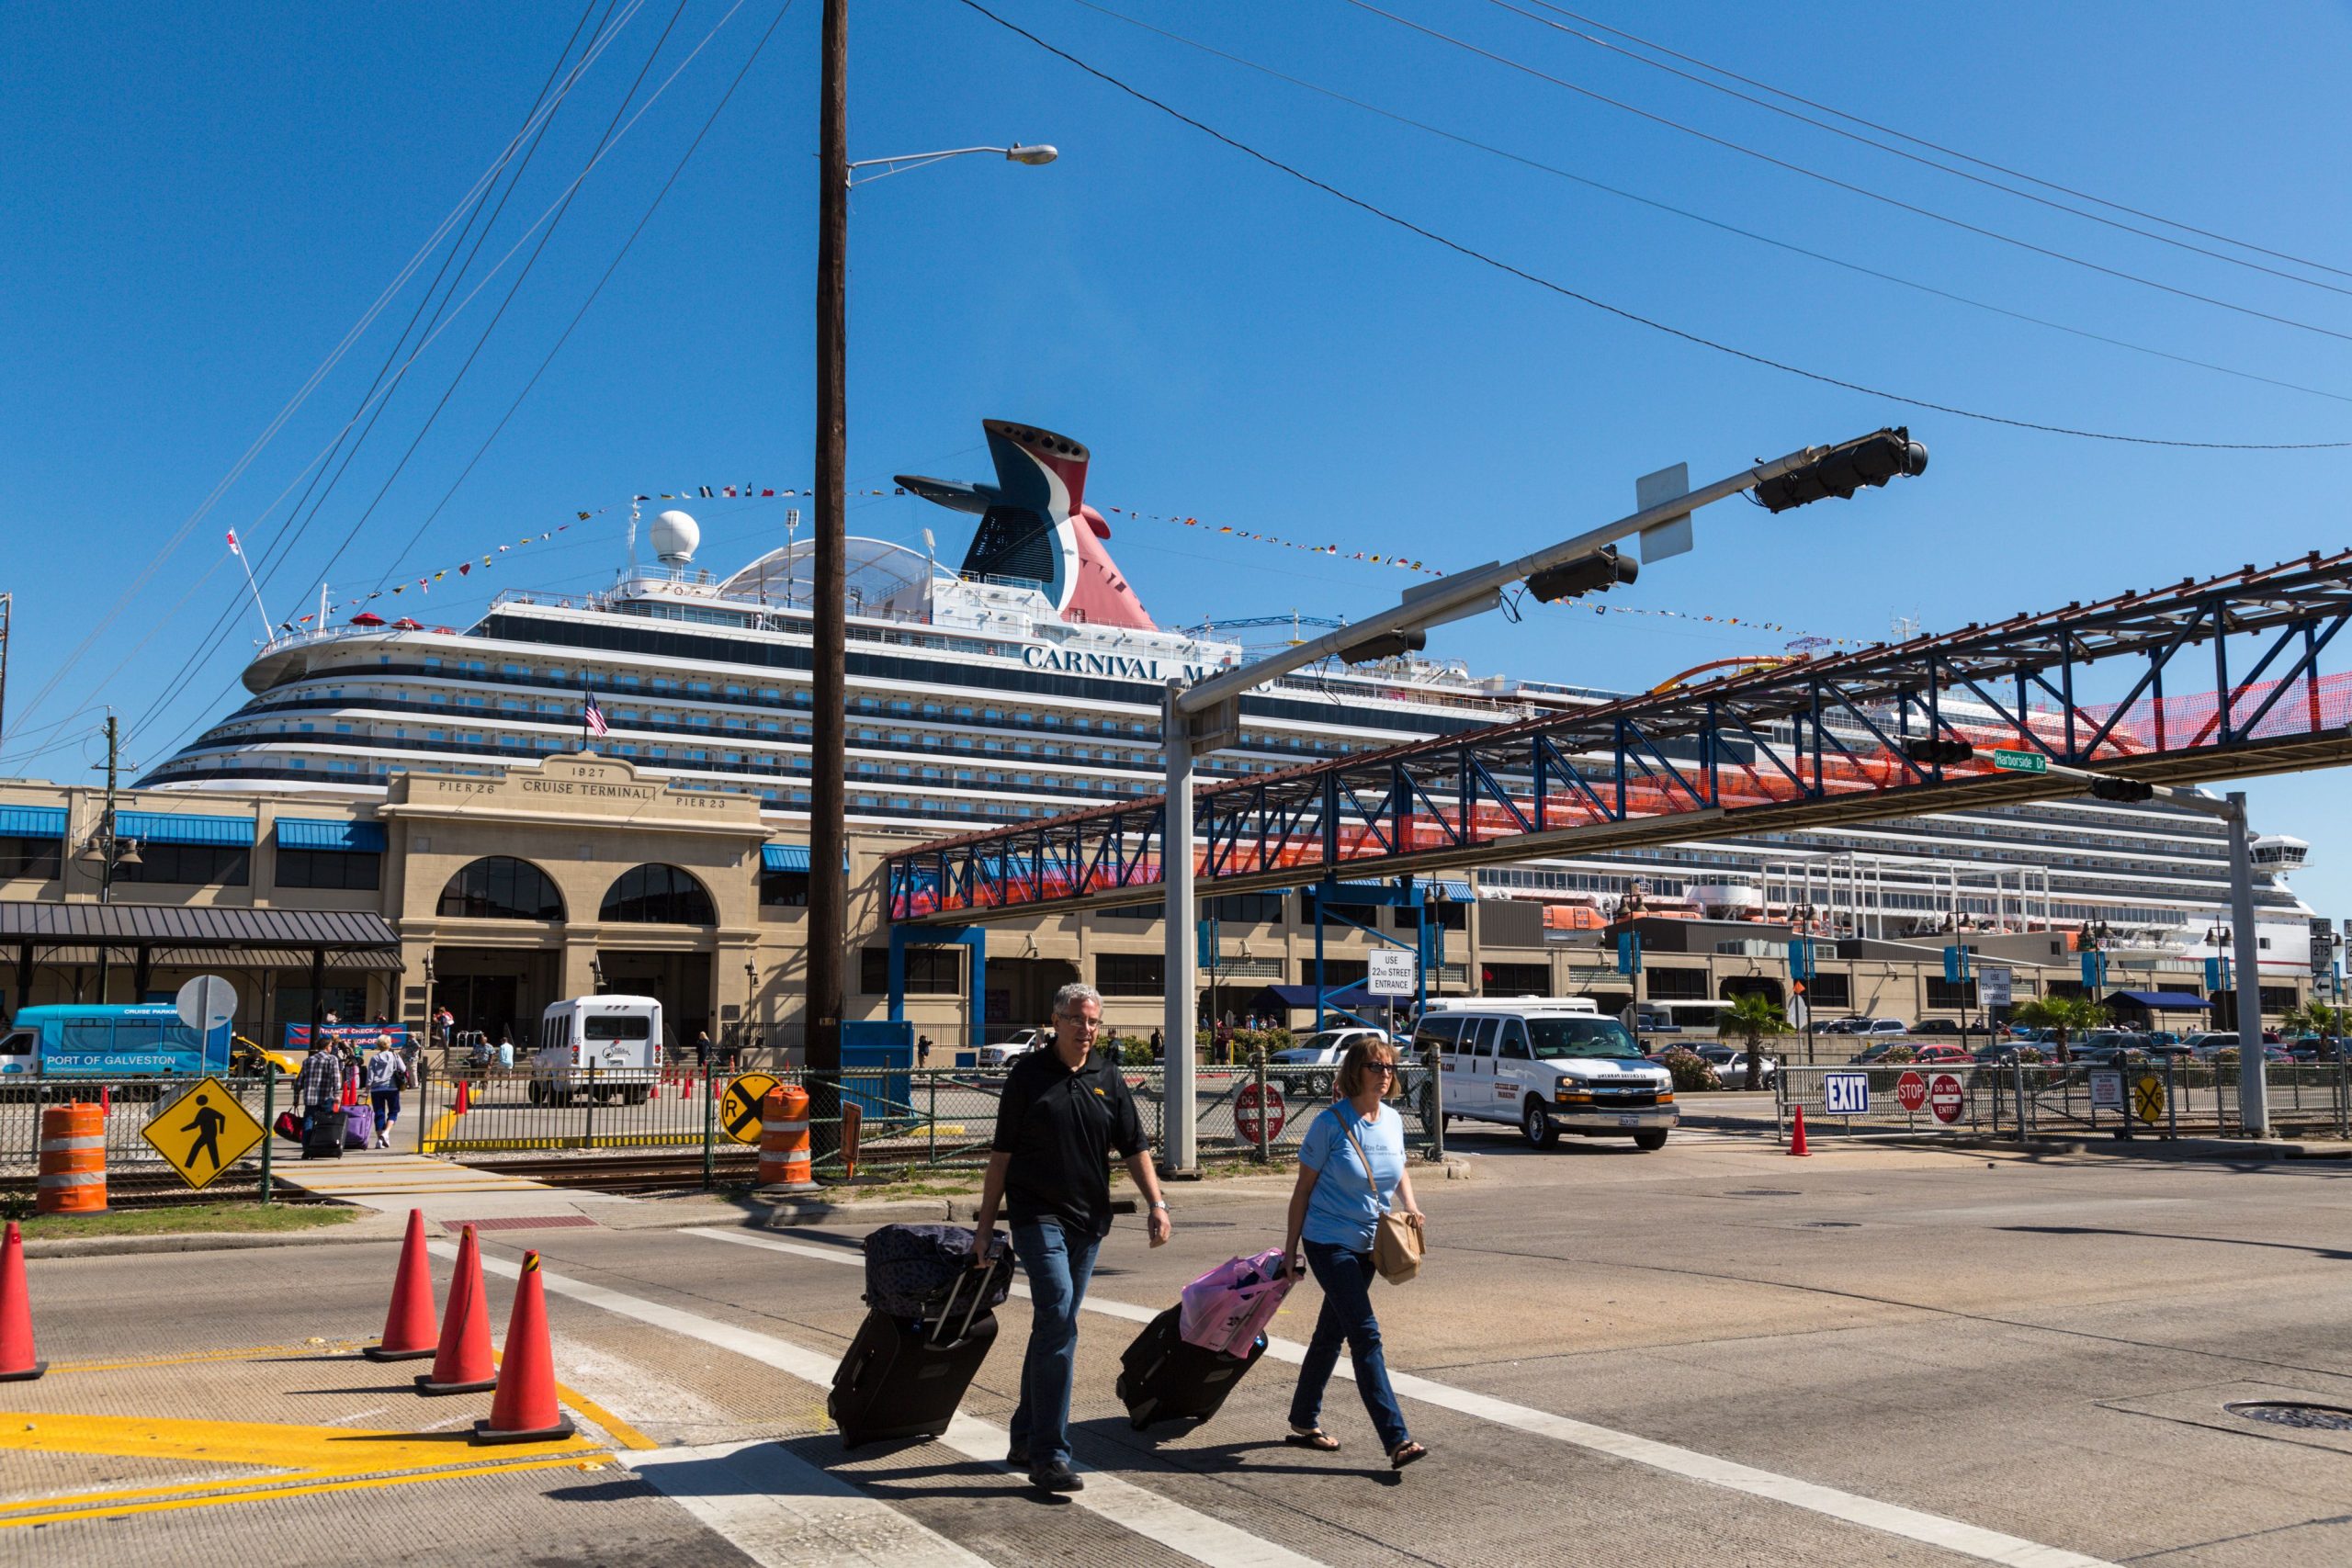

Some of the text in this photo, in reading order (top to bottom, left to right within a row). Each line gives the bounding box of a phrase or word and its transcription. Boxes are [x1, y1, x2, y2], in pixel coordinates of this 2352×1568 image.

[1023, 646, 1166, 681] CARNIVAL
[1996, 753, 2044, 769] Harborside Dr
[572, 767, 605, 778] 1927
[439, 782, 494, 794] PIER 26
[523, 781, 650, 799] CRUISE TERMINAL
[676, 797, 726, 808] PIER 23
[2312, 922, 2328, 931] WEST
[2313, 944, 2329, 956] 275
[1385, 956, 1398, 964] USE
[1388, 968, 1411, 976] STREET
[1375, 980, 1408, 988] ENTRANCE
[47, 1056, 176, 1066] PORT OF GALVESTON
[1899, 1083, 1924, 1100] STOP
[1934, 1084, 1958, 1092] DO NOT
[1827, 1077, 1866, 1111] EXIT
[2155, 1093, 2163, 1103] R
[1241, 1095, 1254, 1105] DO
[725, 1100, 738, 1118] R
[1938, 1106, 1958, 1114] ENTER
